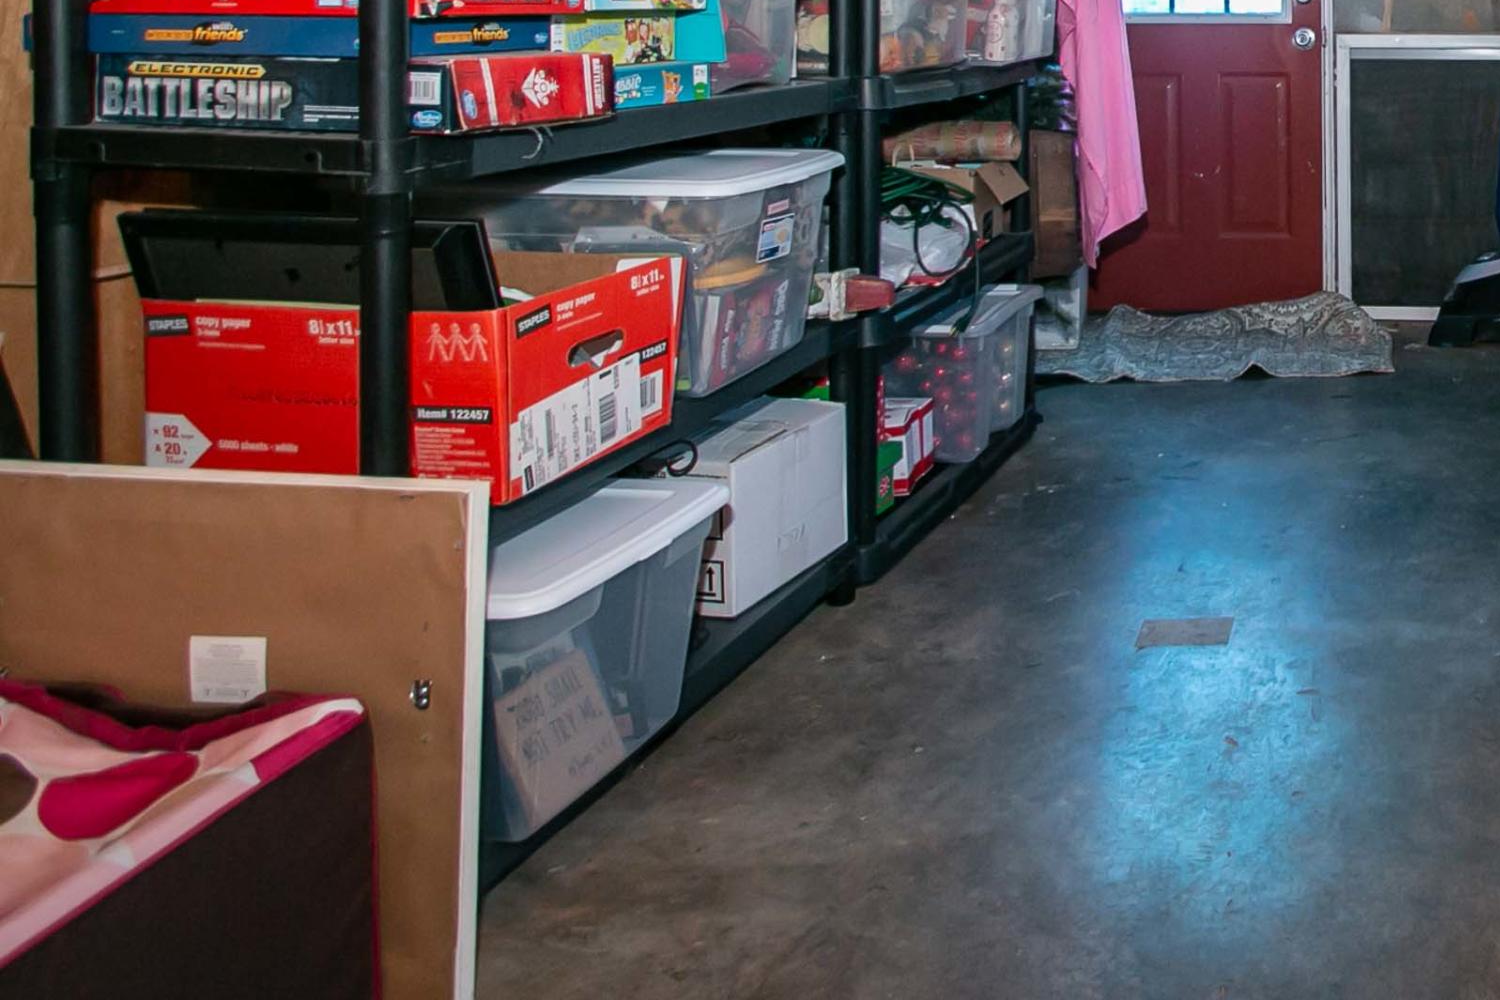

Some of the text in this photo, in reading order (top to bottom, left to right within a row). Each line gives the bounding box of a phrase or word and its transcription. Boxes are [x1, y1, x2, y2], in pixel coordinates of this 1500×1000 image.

[194, 26, 244, 42] friends
[472, 27, 508, 41] friends
[134, 63, 260, 77] ELECTRONIC
[102, 76, 293, 121] BATTLESHIP
[148, 318, 188, 331] STAPLES
[195, 316, 251, 330] copy paper
[518, 308, 550, 333] STAPLES
[450, 408, 490, 421] 122457
[162, 424, 180, 439] 92
[163, 442, 181, 456] 20
